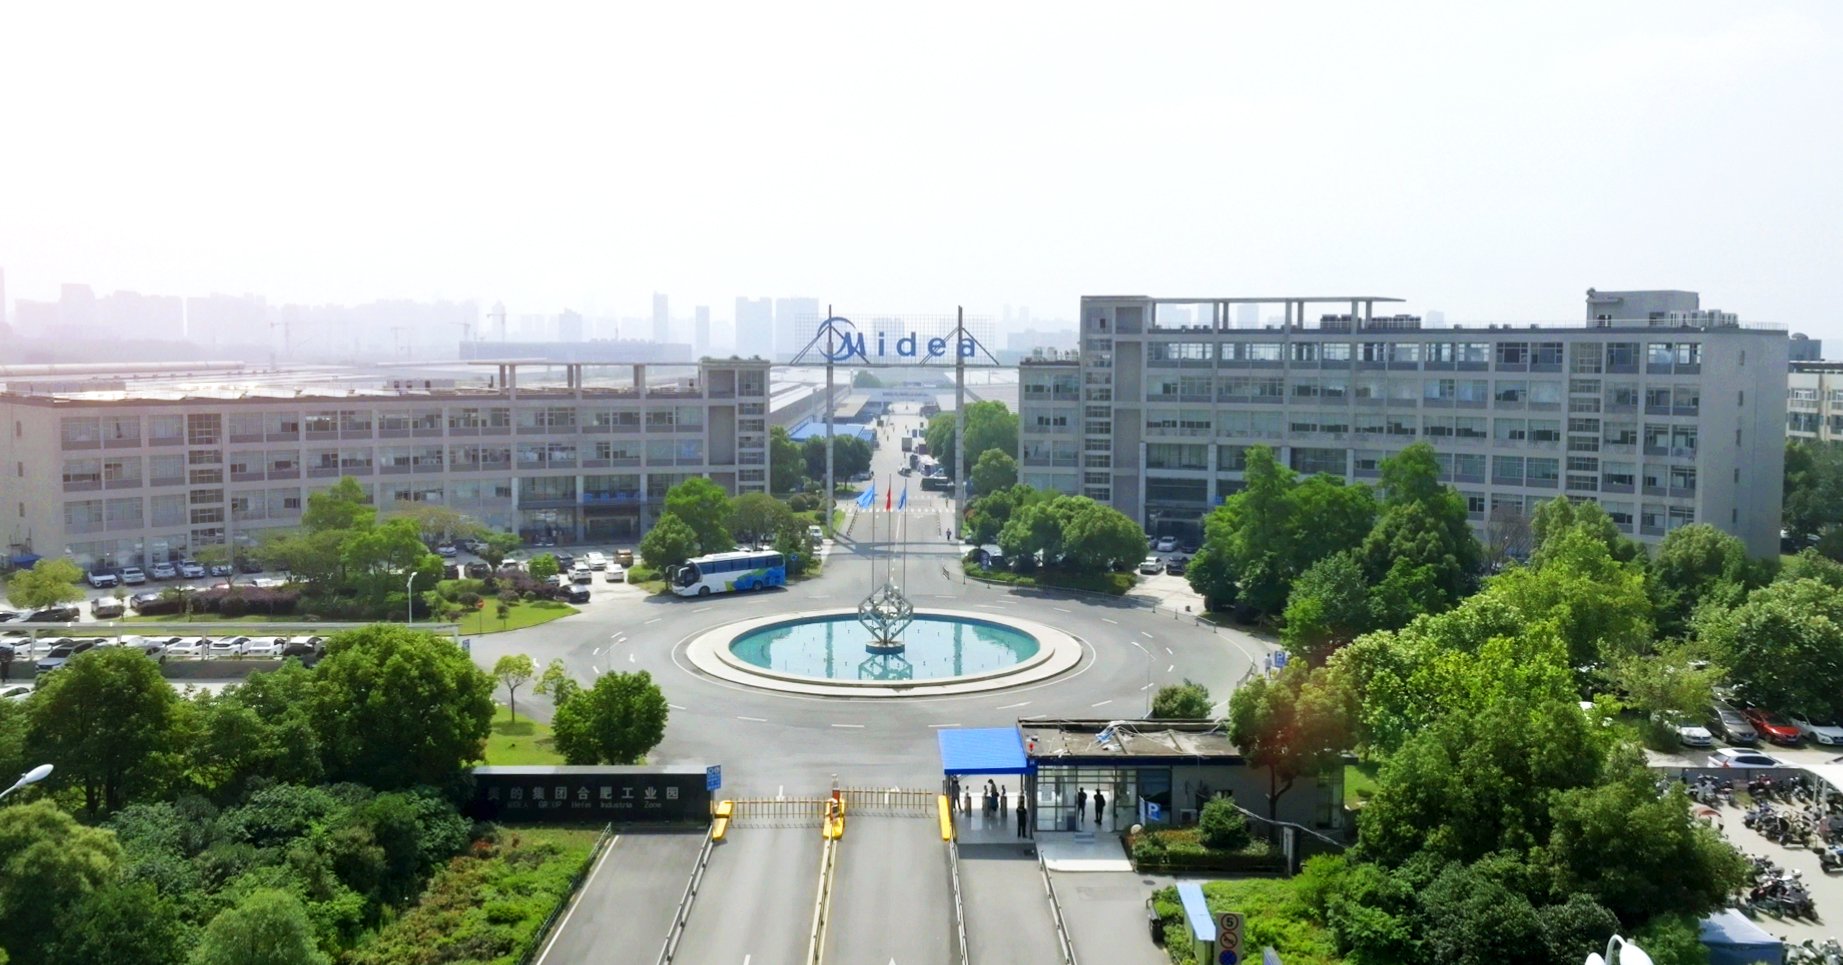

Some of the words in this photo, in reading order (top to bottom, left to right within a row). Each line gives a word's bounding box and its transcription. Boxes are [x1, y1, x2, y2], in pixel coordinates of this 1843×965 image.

[817, 331, 975, 361] Midea
[538, 801, 562, 809] GRUP
[1148, 801, 1159, 816] P
[1226, 917, 1233, 927] 5
